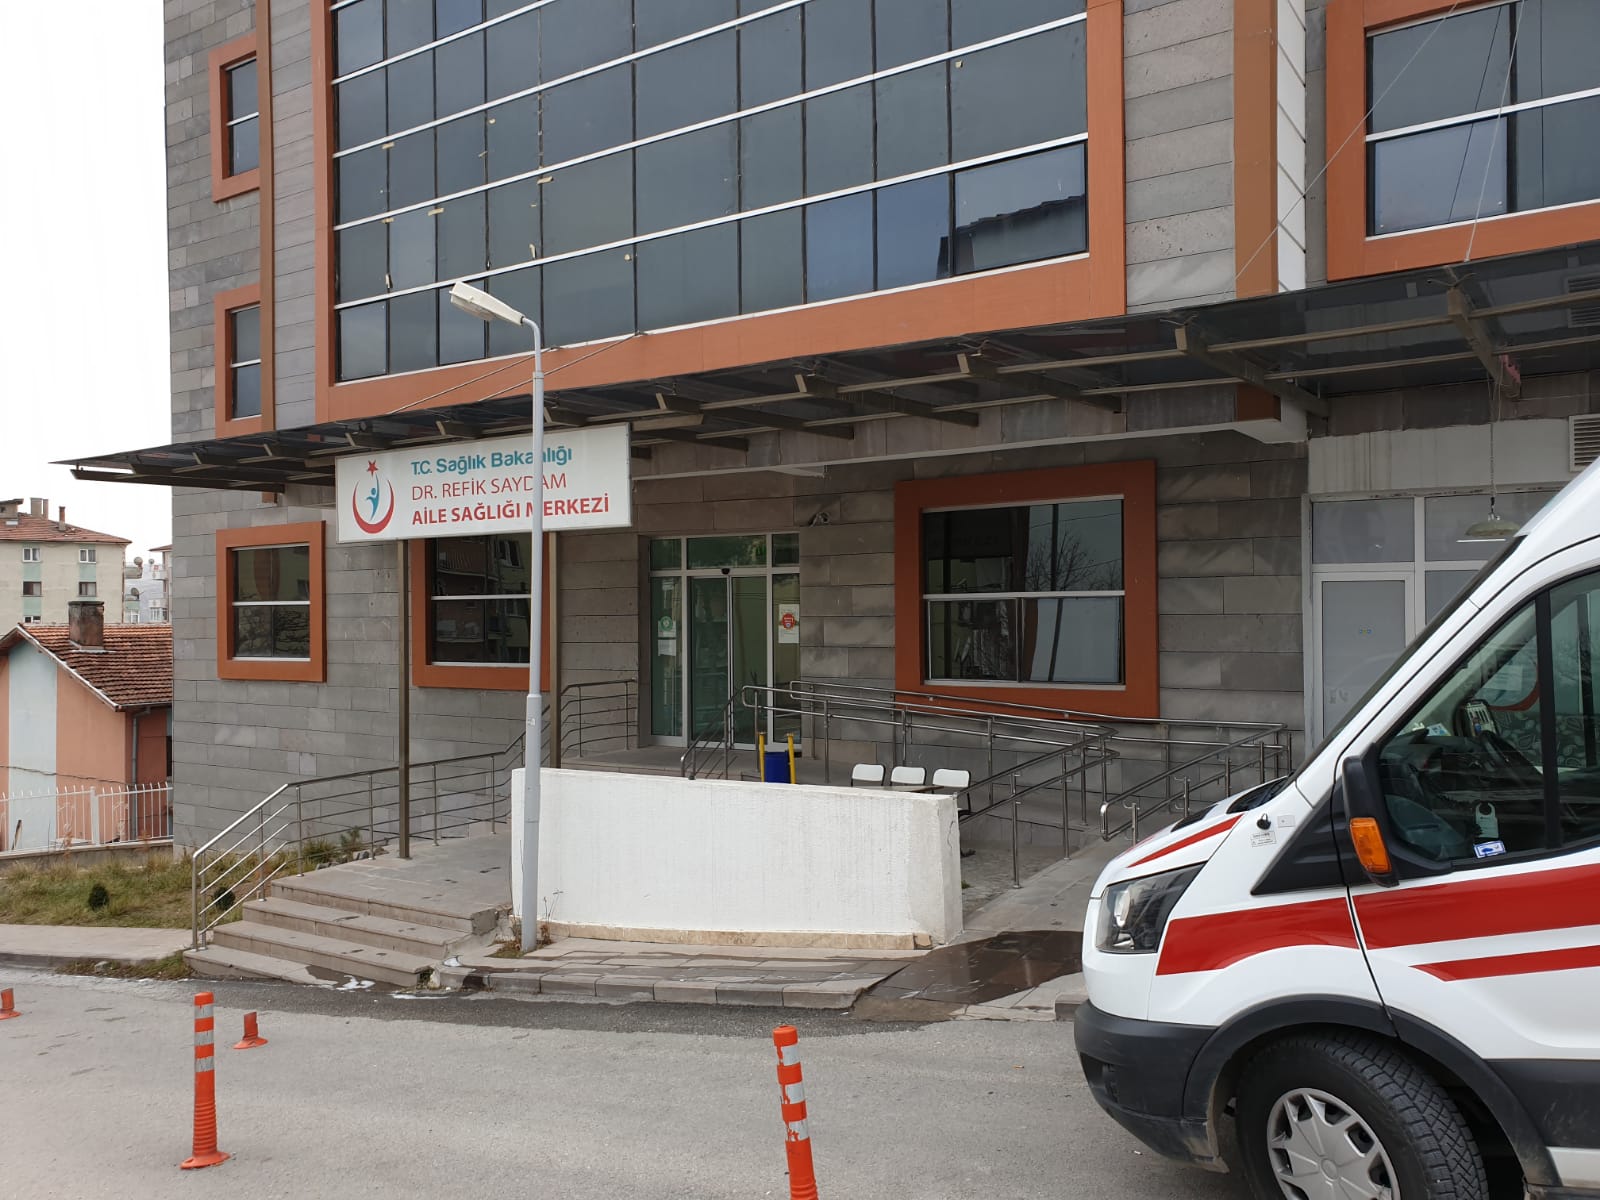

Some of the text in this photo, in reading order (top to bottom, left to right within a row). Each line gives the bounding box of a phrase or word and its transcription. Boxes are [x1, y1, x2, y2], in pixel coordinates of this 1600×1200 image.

[436, 454, 487, 475] Sağlık
[412, 485, 437, 501] DR.
[442, 478, 487, 498] REFİK
[412, 506, 447, 525] AİLE
[451, 500, 521, 522] SAĞLIĞI
